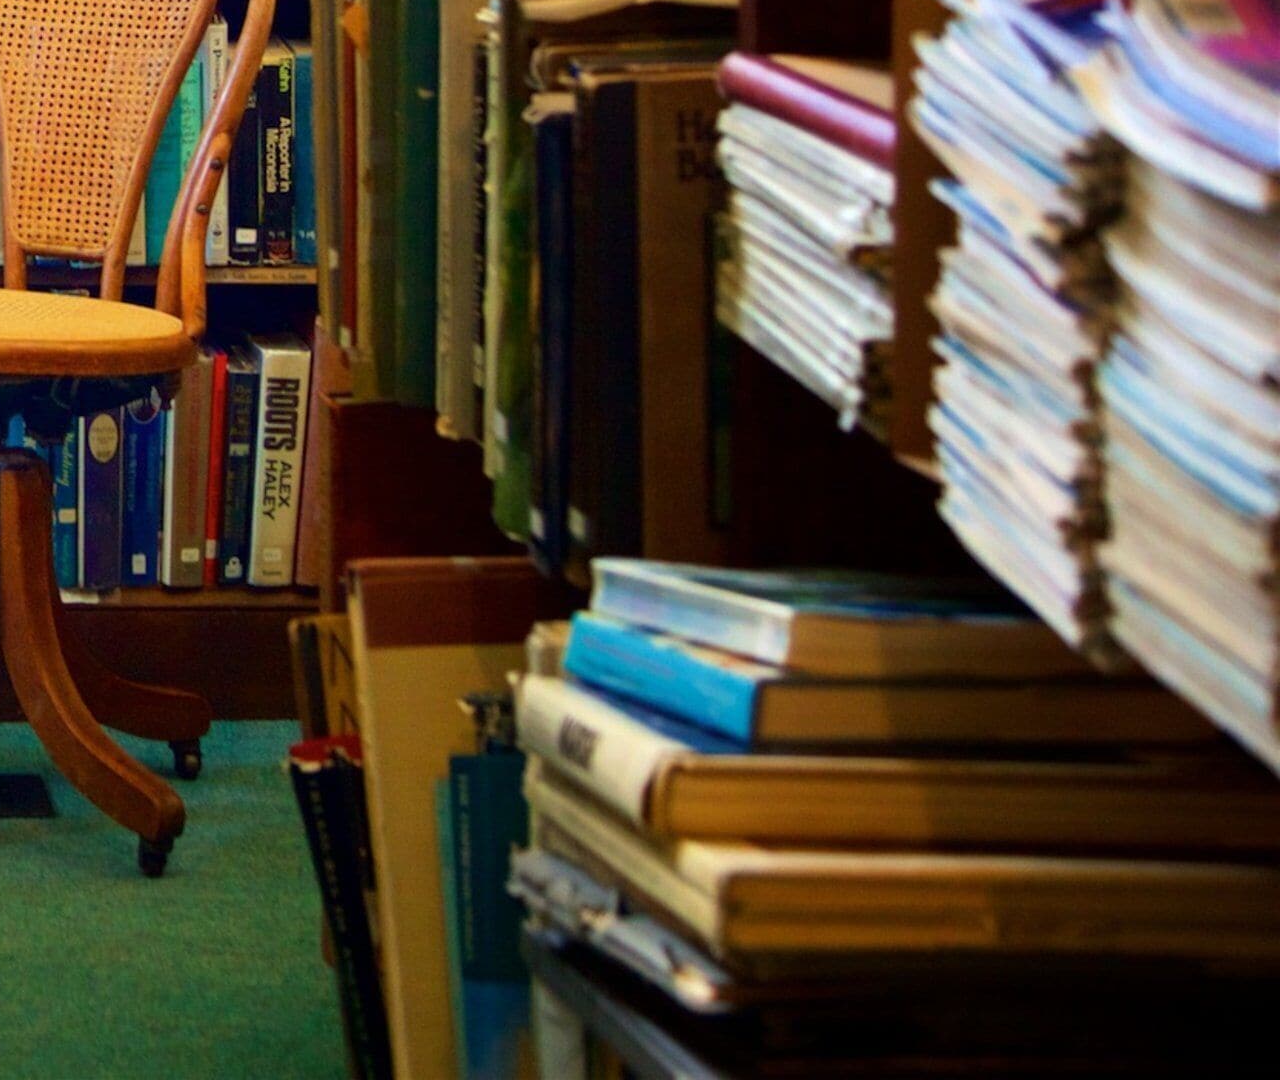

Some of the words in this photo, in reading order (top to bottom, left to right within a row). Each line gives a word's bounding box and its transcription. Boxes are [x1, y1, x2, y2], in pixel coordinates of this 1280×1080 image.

[278, 61, 291, 92] Kahn
[279, 116, 291, 127] A
[264, 127, 278, 193] Micronesia
[277, 126, 291, 176] Reporter
[279, 178, 291, 193] in
[263, 378, 301, 450] ROOTS
[261, 458, 278, 523] HALEY
[278, 460, 293, 508] ALEX
